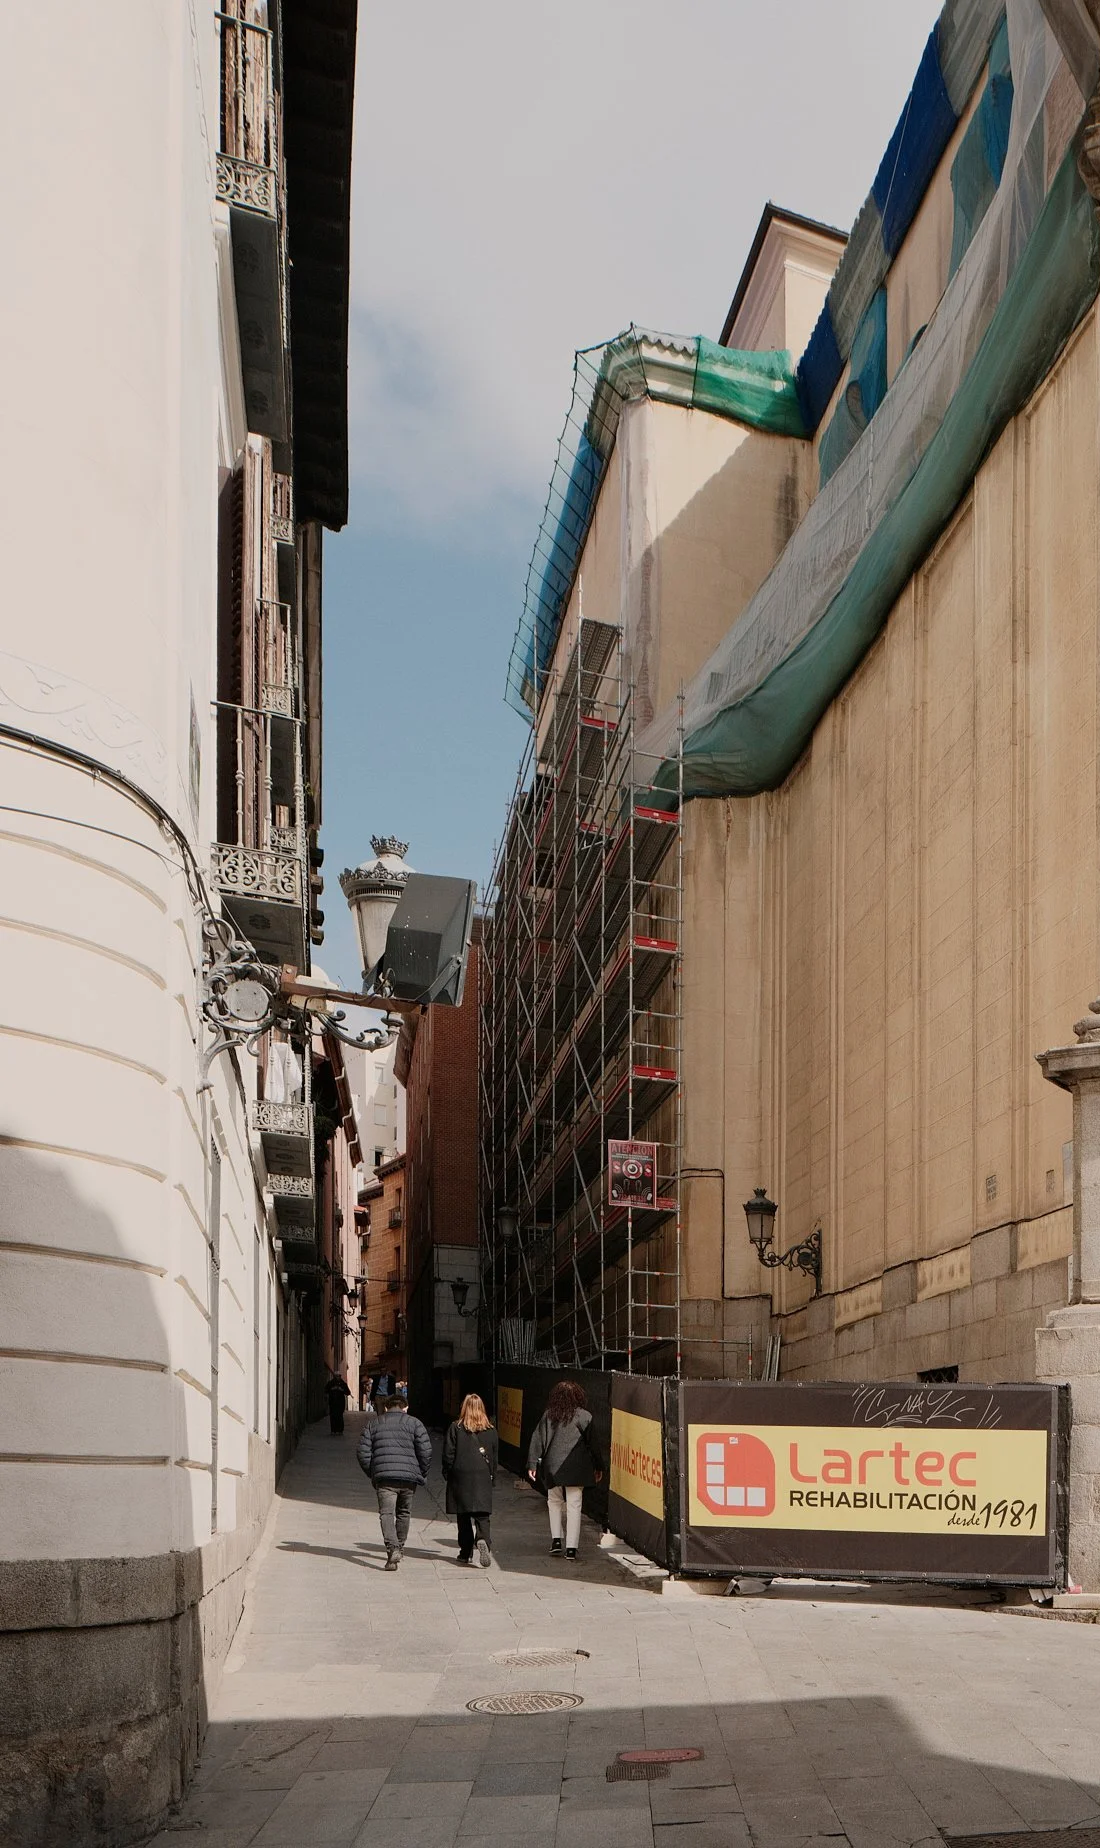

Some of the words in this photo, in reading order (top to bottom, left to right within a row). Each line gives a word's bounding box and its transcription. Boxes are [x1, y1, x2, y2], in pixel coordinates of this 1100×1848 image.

[789, 1442, 977, 1487] Lartec
[789, 1490, 976, 1511] REHABILITACIÓN
[947, 1512, 981, 1527] desde
[980, 1499, 1038, 1530] 1981
